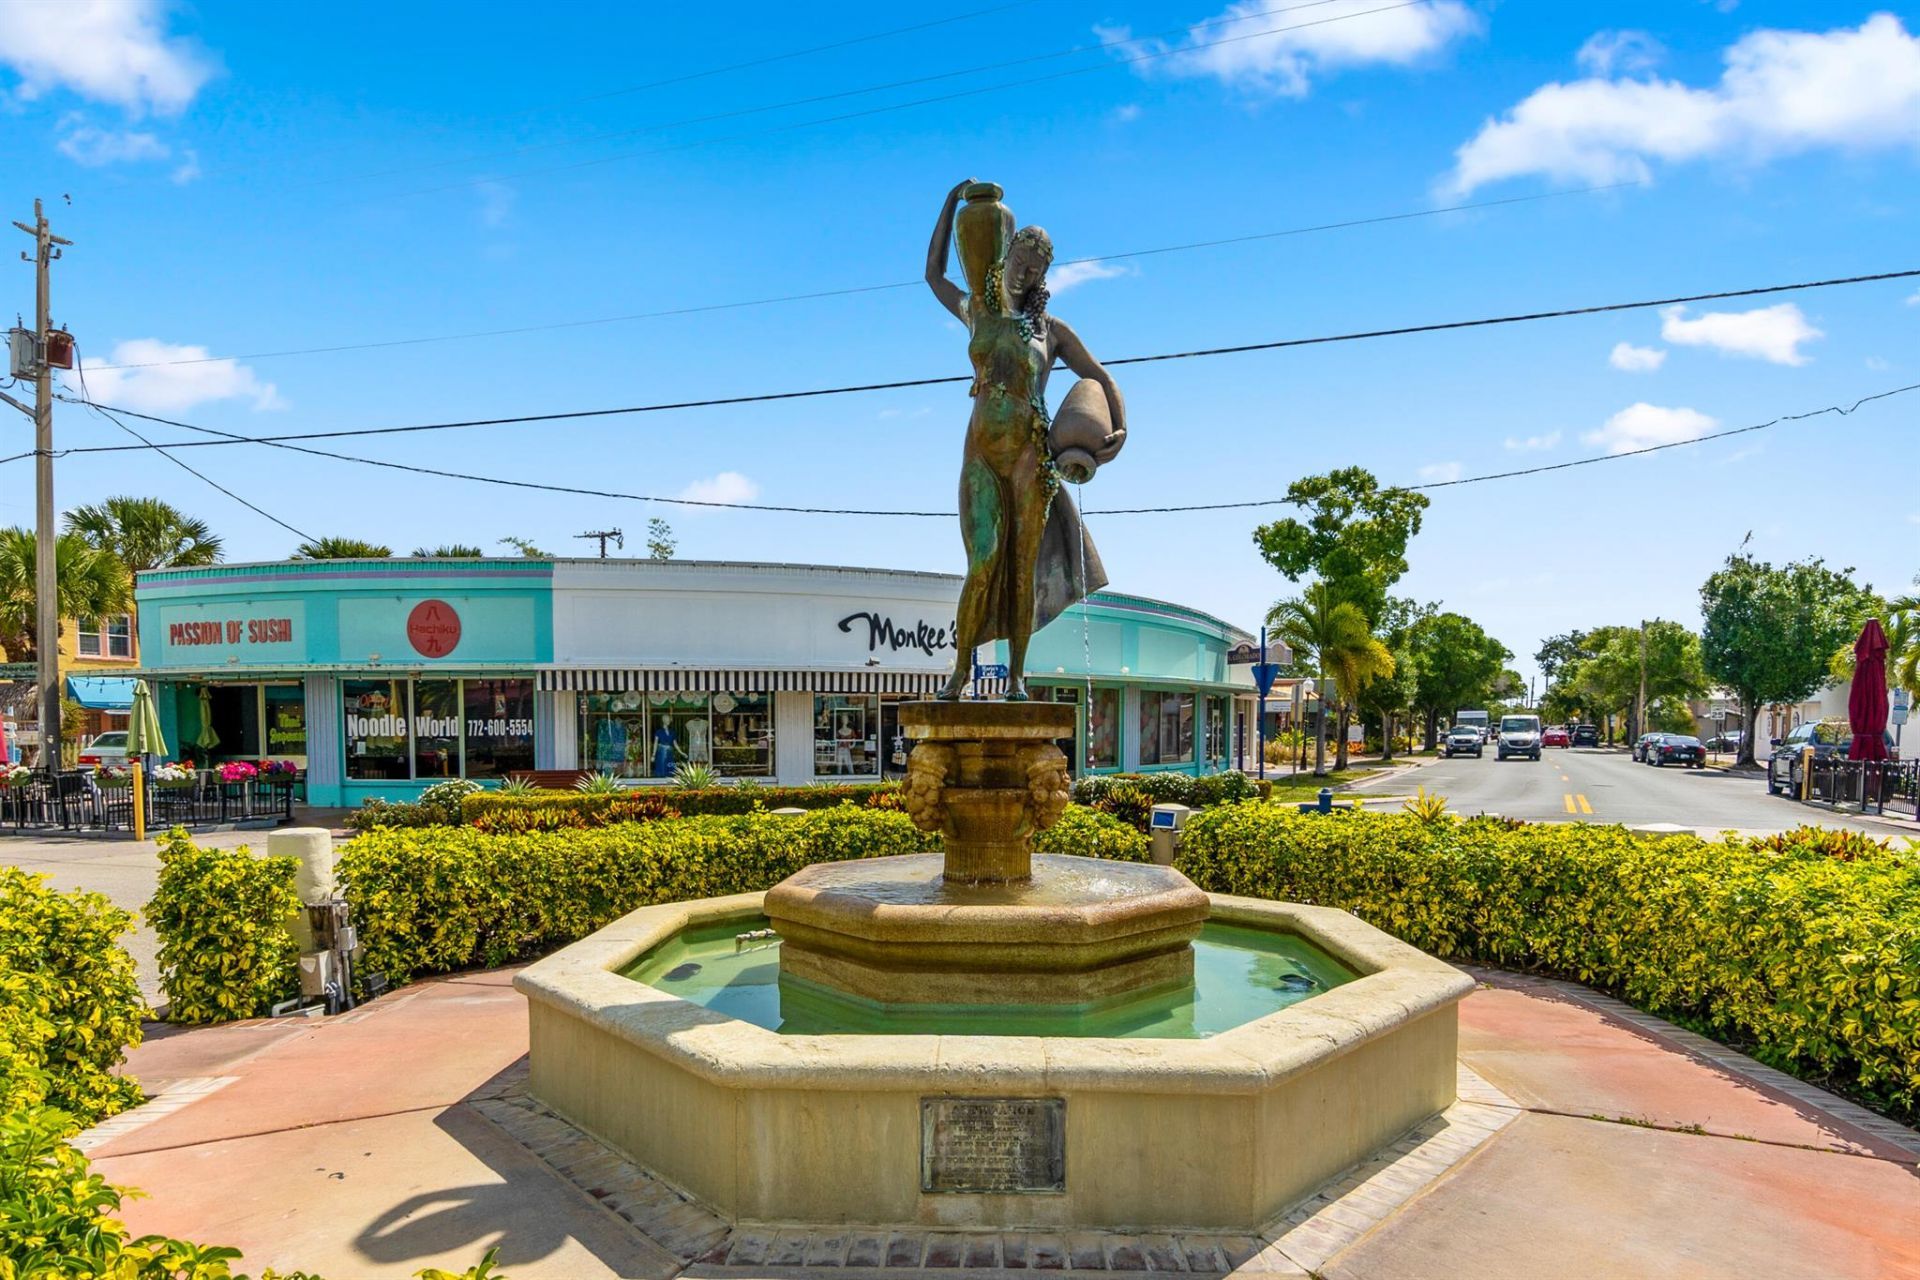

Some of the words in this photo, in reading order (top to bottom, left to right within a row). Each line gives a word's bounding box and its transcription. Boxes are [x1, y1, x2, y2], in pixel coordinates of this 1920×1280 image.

[169, 621, 223, 646] PASSION
[226, 620, 243, 645] OF
[247, 618, 292, 644] SUSHI
[409, 624, 457, 634] Hachiku
[837, 611, 958, 657] Monkee's
[347, 714, 406, 737] Noodle
[416, 716, 459, 737] World
[467, 719, 533, 737] 772-600-5554
